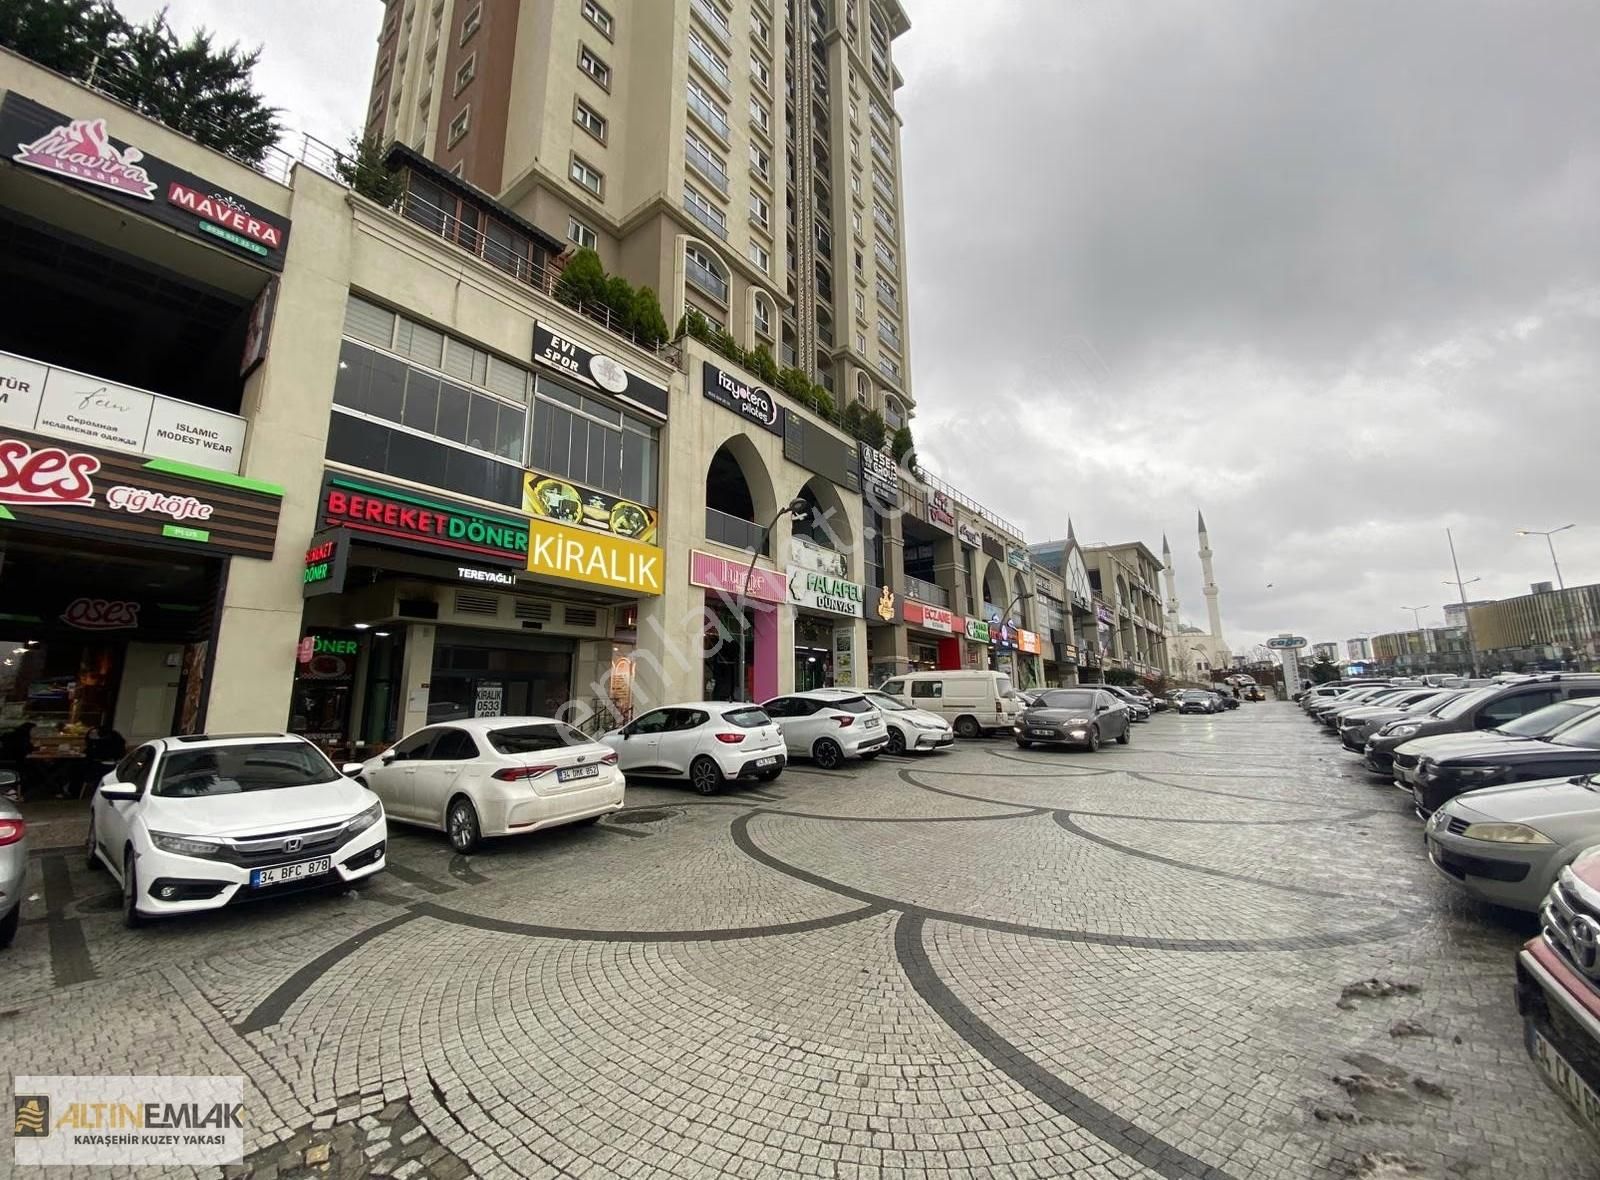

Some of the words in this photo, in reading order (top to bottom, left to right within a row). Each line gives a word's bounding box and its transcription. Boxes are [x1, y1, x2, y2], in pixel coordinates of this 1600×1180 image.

[171, 186, 278, 245] MAVERA
[543, 348, 579, 373] SPOR
[66, 414, 118, 433] Скромная
[742, 402, 769, 423] pilates
[156, 428, 203, 447] MODEST
[203, 438, 233, 454] WEAR
[176, 422, 219, 440] ISLAMIC
[0, 442, 99, 500] ses
[873, 450, 898, 471] ESER
[873, 462, 898, 481] GROUP
[327, 490, 449, 535] BEREKET
[448, 516, 528, 551] DÖNER
[533, 533, 659, 588] KİRALIK
[806, 572, 863, 603] FALAFEL
[313, 635, 358, 654] ÖNER
[260, 870, 274, 884] 34
[281, 864, 302, 879] BFC
[308, 859, 328, 873] 878
